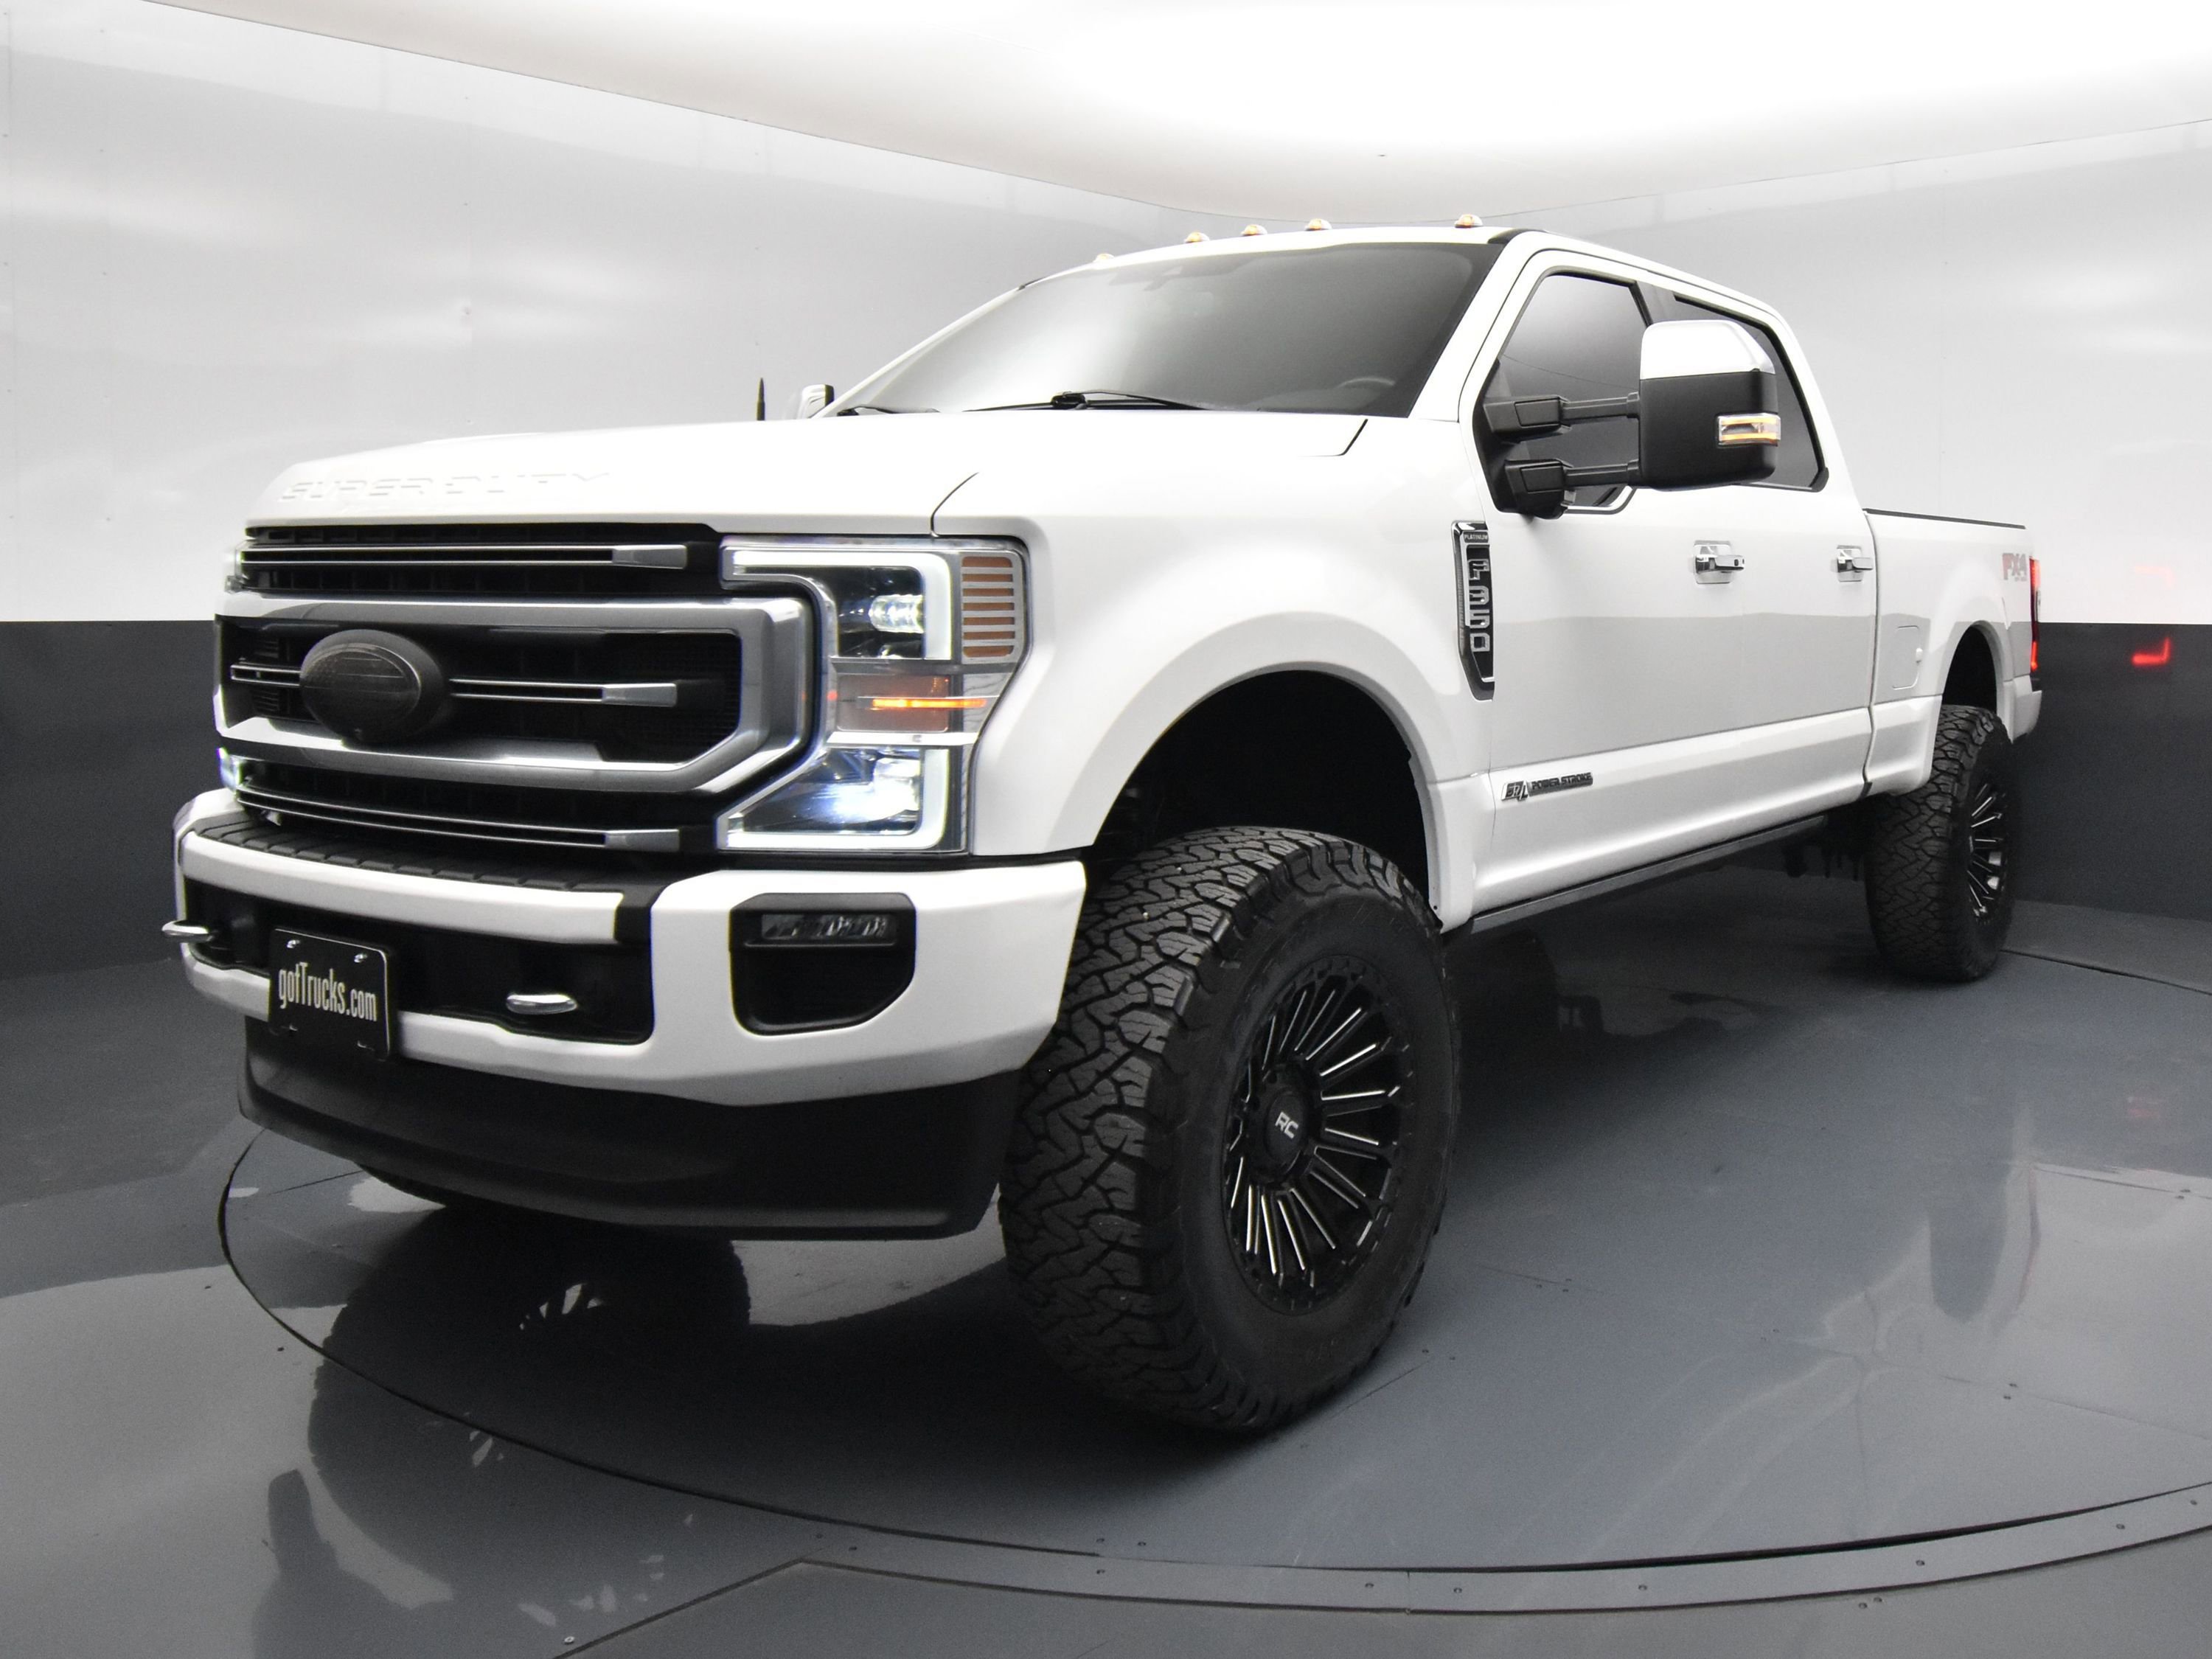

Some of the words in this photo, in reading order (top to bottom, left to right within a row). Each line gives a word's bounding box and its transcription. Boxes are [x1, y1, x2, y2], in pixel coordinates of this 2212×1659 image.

[2002, 553, 2027, 581] FX4
[1561, 772, 1593, 785] STROKE
[279, 961, 377, 1022] gotTrucks.com
[1275, 1112, 1299, 1138] RC
